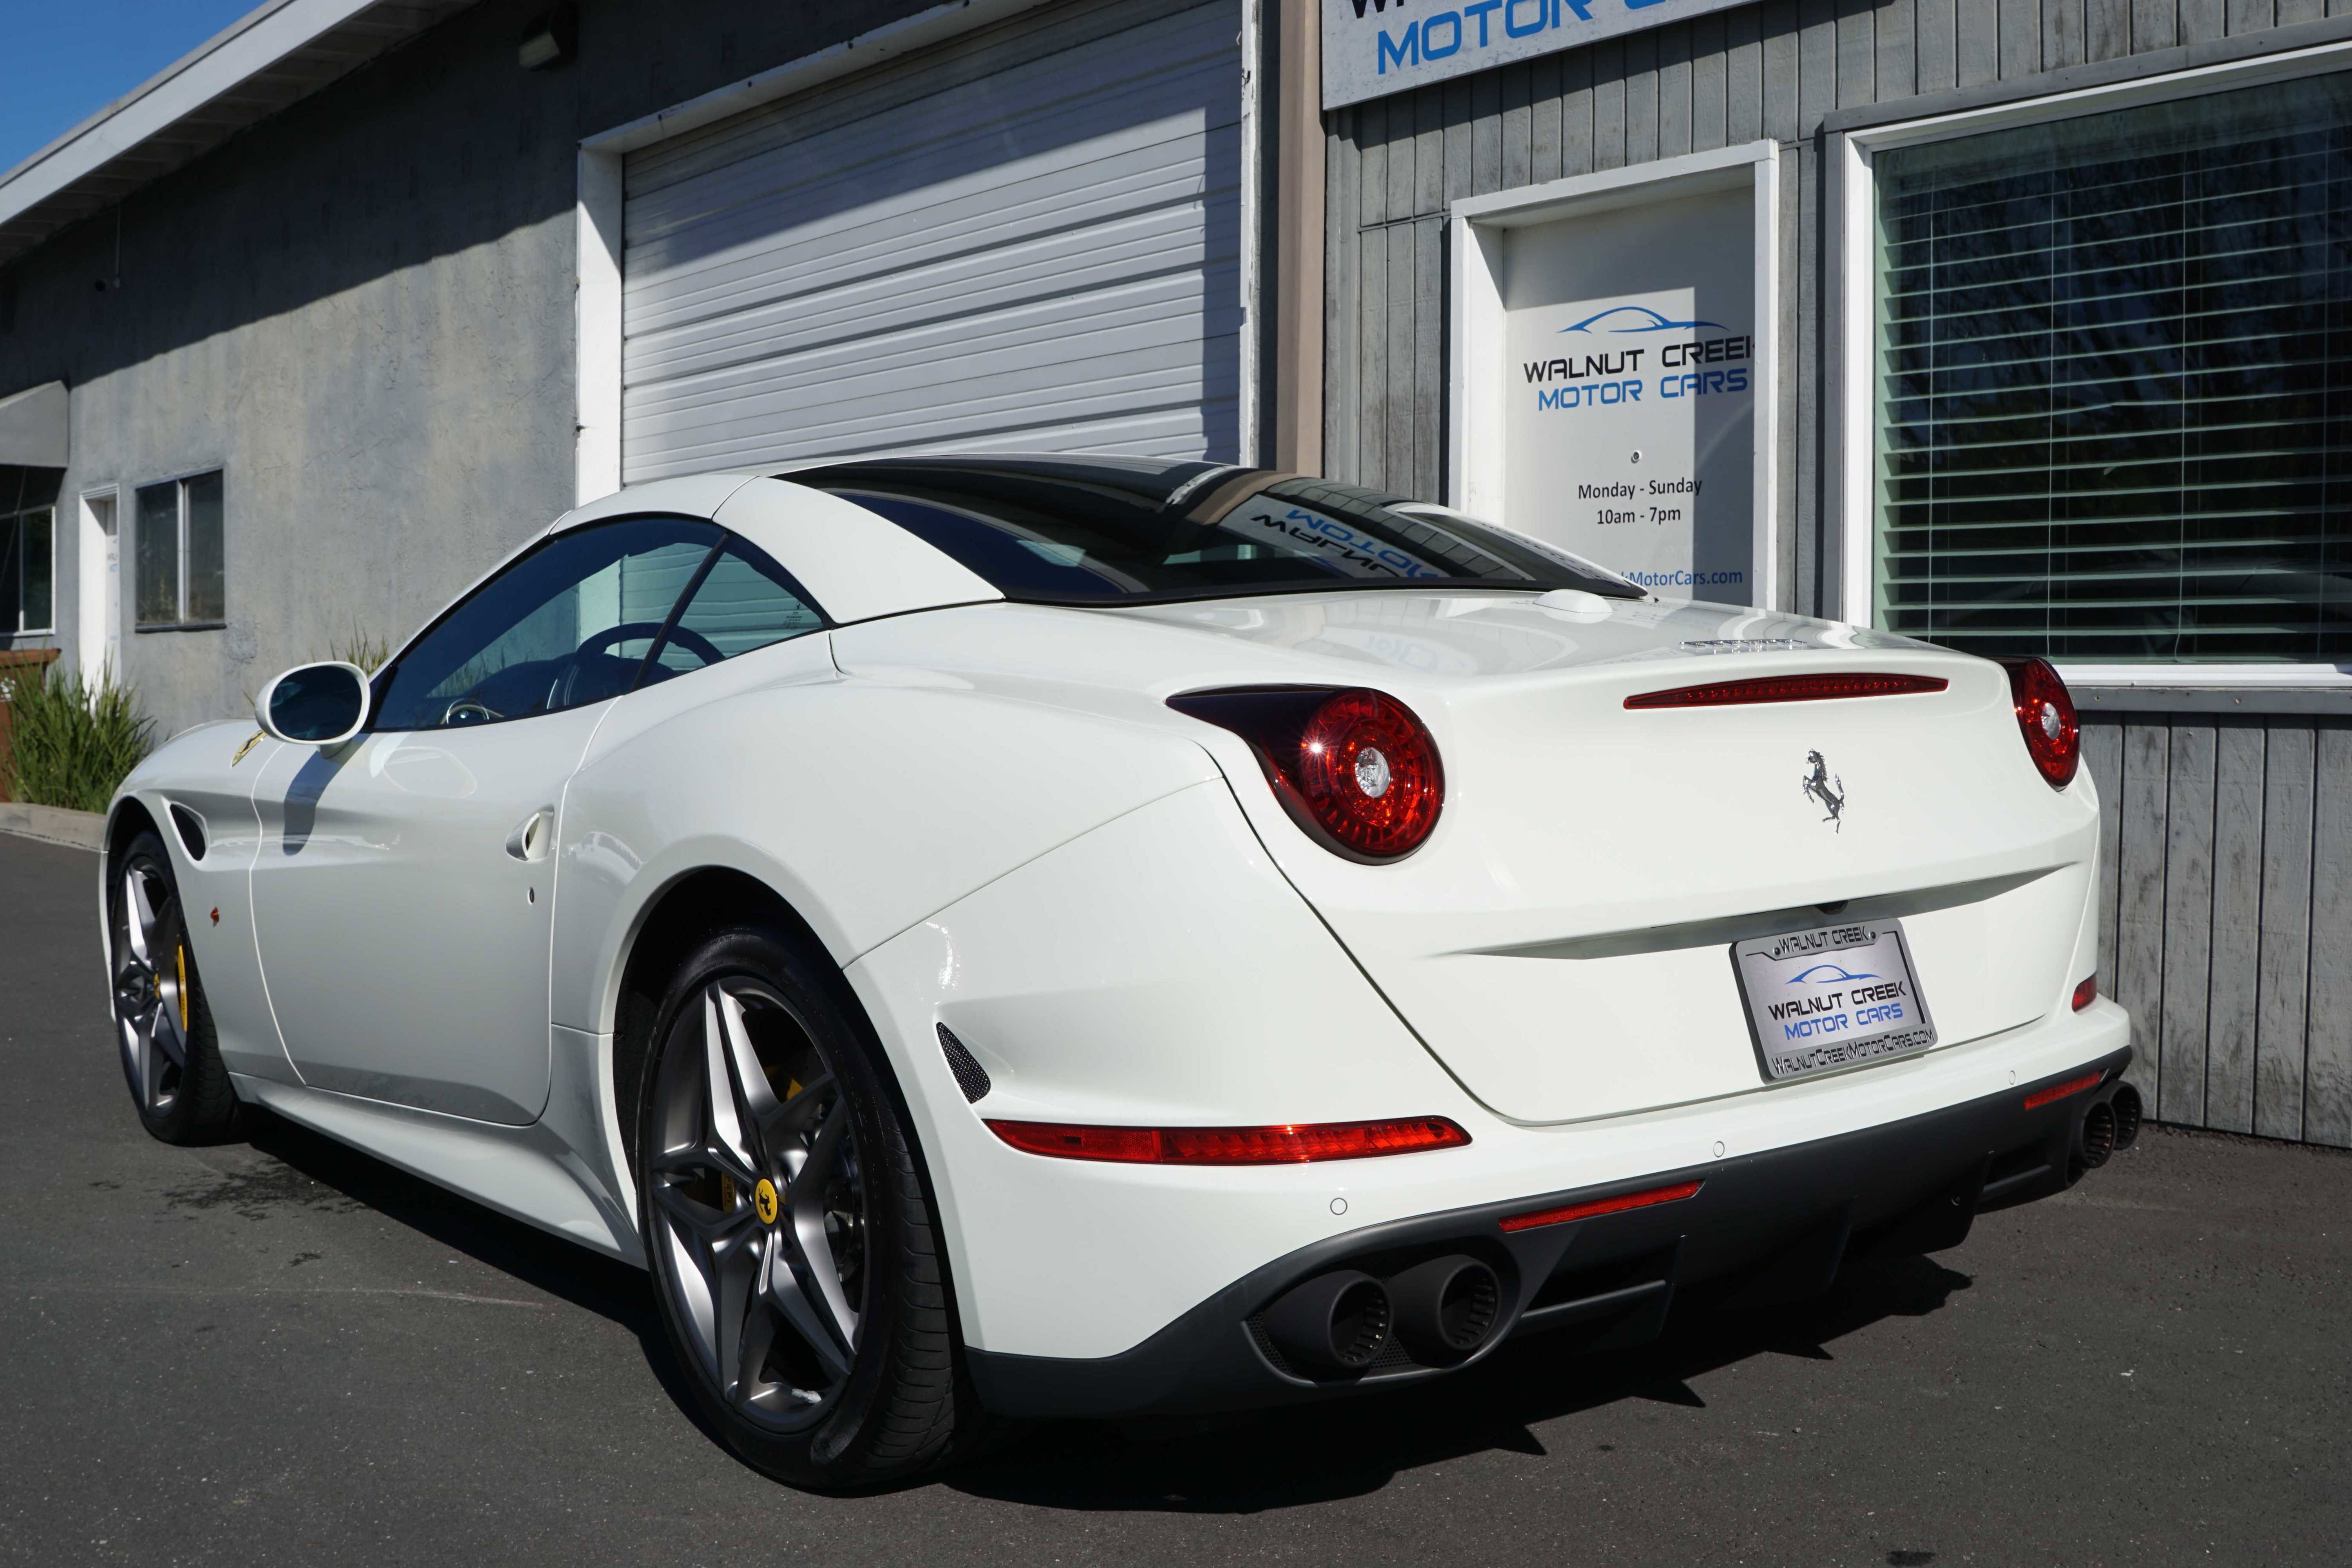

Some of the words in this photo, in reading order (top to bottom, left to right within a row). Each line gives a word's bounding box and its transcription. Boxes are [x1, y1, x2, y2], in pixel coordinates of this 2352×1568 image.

[1378, 0, 1593, 75] MOTOR
[1523, 349, 1644, 383] WALNUT
[1538, 379, 1643, 411] MOTOR
[1660, 368, 1748, 399] CARS
[1578, 481, 1635, 499] Monday
[1648, 477, 1702, 496] Sunday
[1597, 509, 1635, 524] 10am
[1649, 506, 1681, 525] 7pm
[1778, 931, 1827, 954] WALNUT
[1832, 926, 1869, 944] CREEK
[1768, 993, 1843, 1020] WALNUT
[1851, 981, 1907, 1005] CREEK
[1784, 1013, 1849, 1040] MOTOR
[1855, 1003, 1904, 1026] CARS
